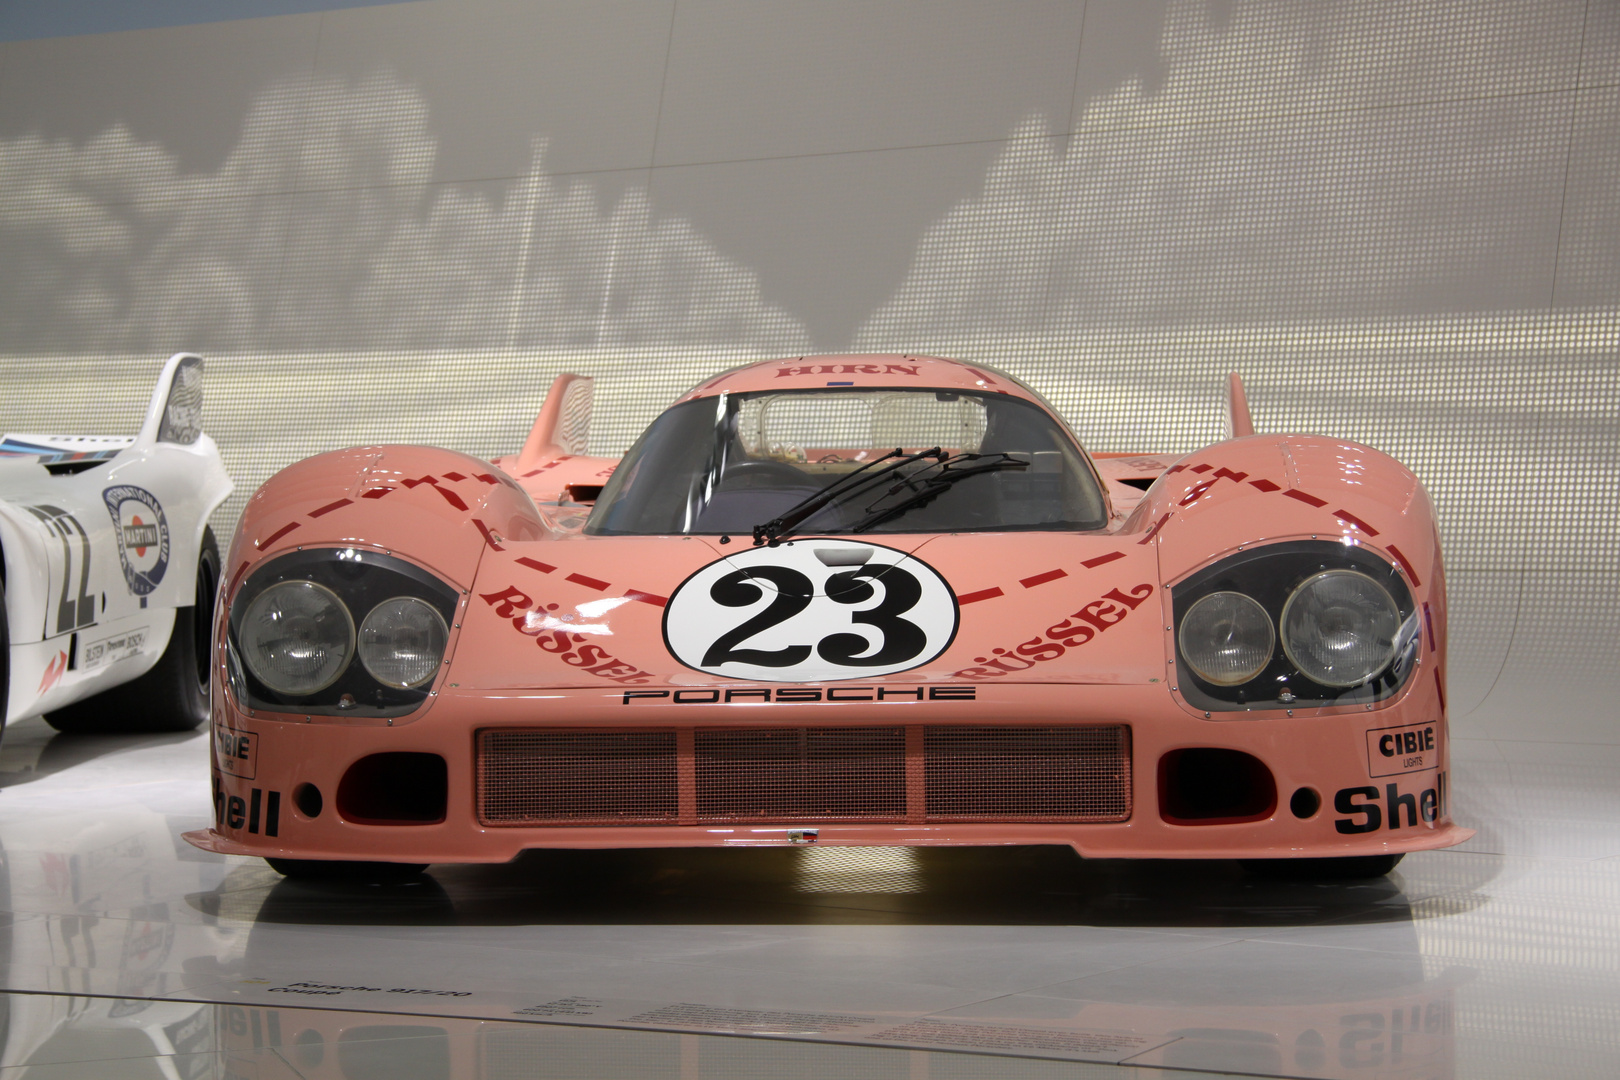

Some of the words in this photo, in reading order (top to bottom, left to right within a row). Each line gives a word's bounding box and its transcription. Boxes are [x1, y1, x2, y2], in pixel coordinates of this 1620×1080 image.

[774, 364, 922, 378] HIRN
[125, 527, 157, 545] MARTINI
[700, 562, 927, 667] 23
[944, 583, 1153, 681] RÜSSEL
[622, 686, 976, 705] PORSCHE
[1403, 756, 1423, 768] LIGHTS
[212, 777, 281, 838] hell
[1334, 771, 1447, 835] Shell
[288, 982, 382, 992] Porsche
